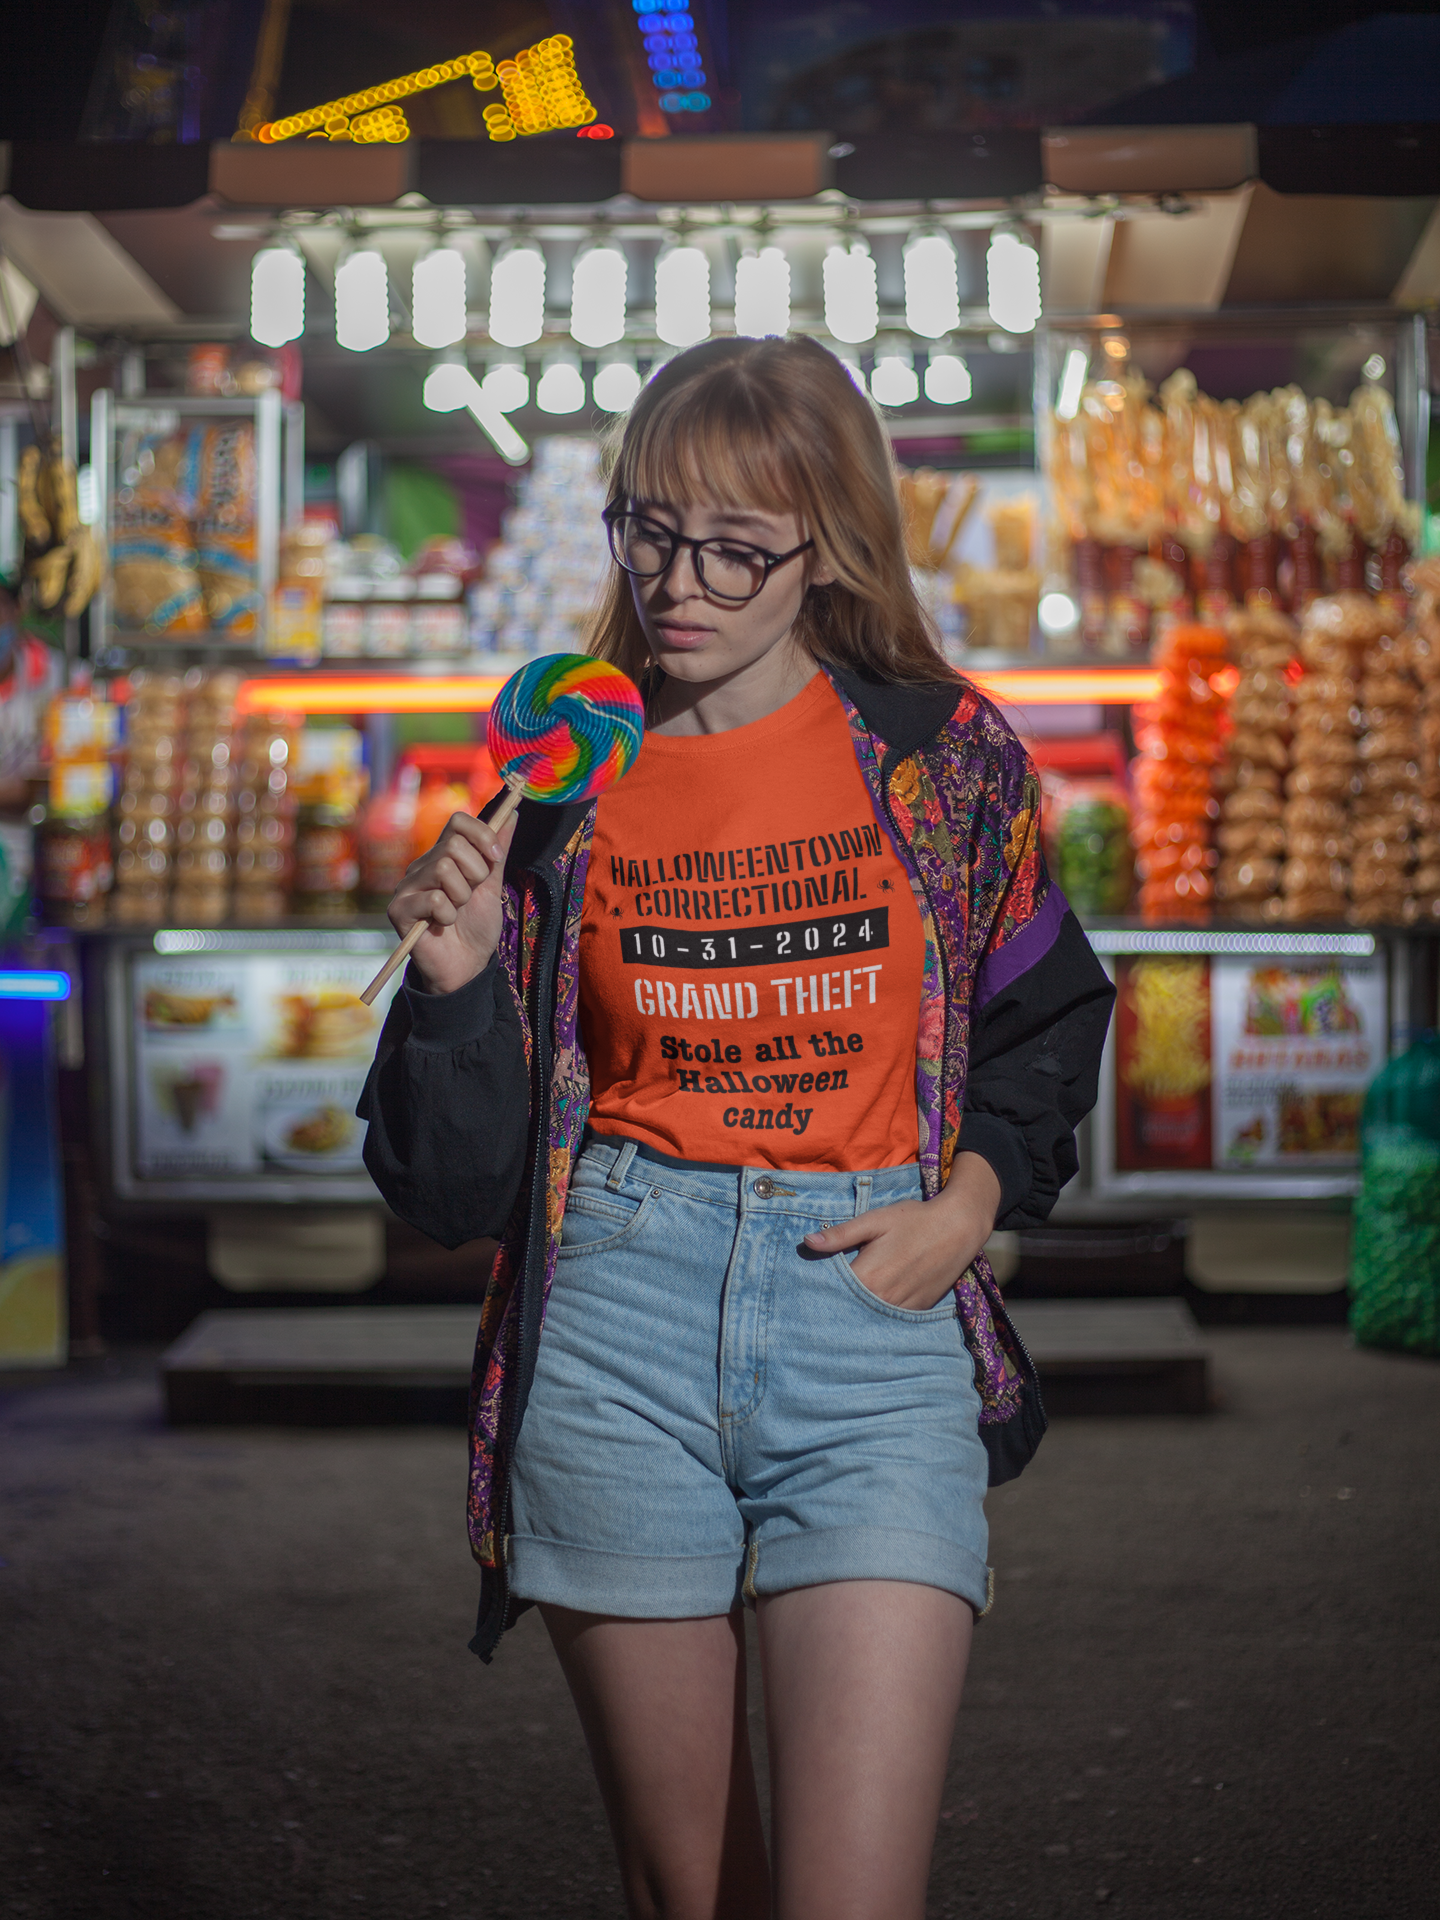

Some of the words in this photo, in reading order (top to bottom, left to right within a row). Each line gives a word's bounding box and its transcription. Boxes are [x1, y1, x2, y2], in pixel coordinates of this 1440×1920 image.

[610, 822, 883, 888] HALLOWEENTOWN
[634, 866, 868, 921] CORRECTIONAL
[634, 978, 759, 1020] GRAND
[770, 963, 883, 1017] THEFT
[660, 1034, 742, 1064] Stole
[755, 1035, 802, 1062] all
[808, 1031, 864, 1057] the
[676, 1068, 849, 1094] Halloween
[723, 1102, 814, 1136] candy
